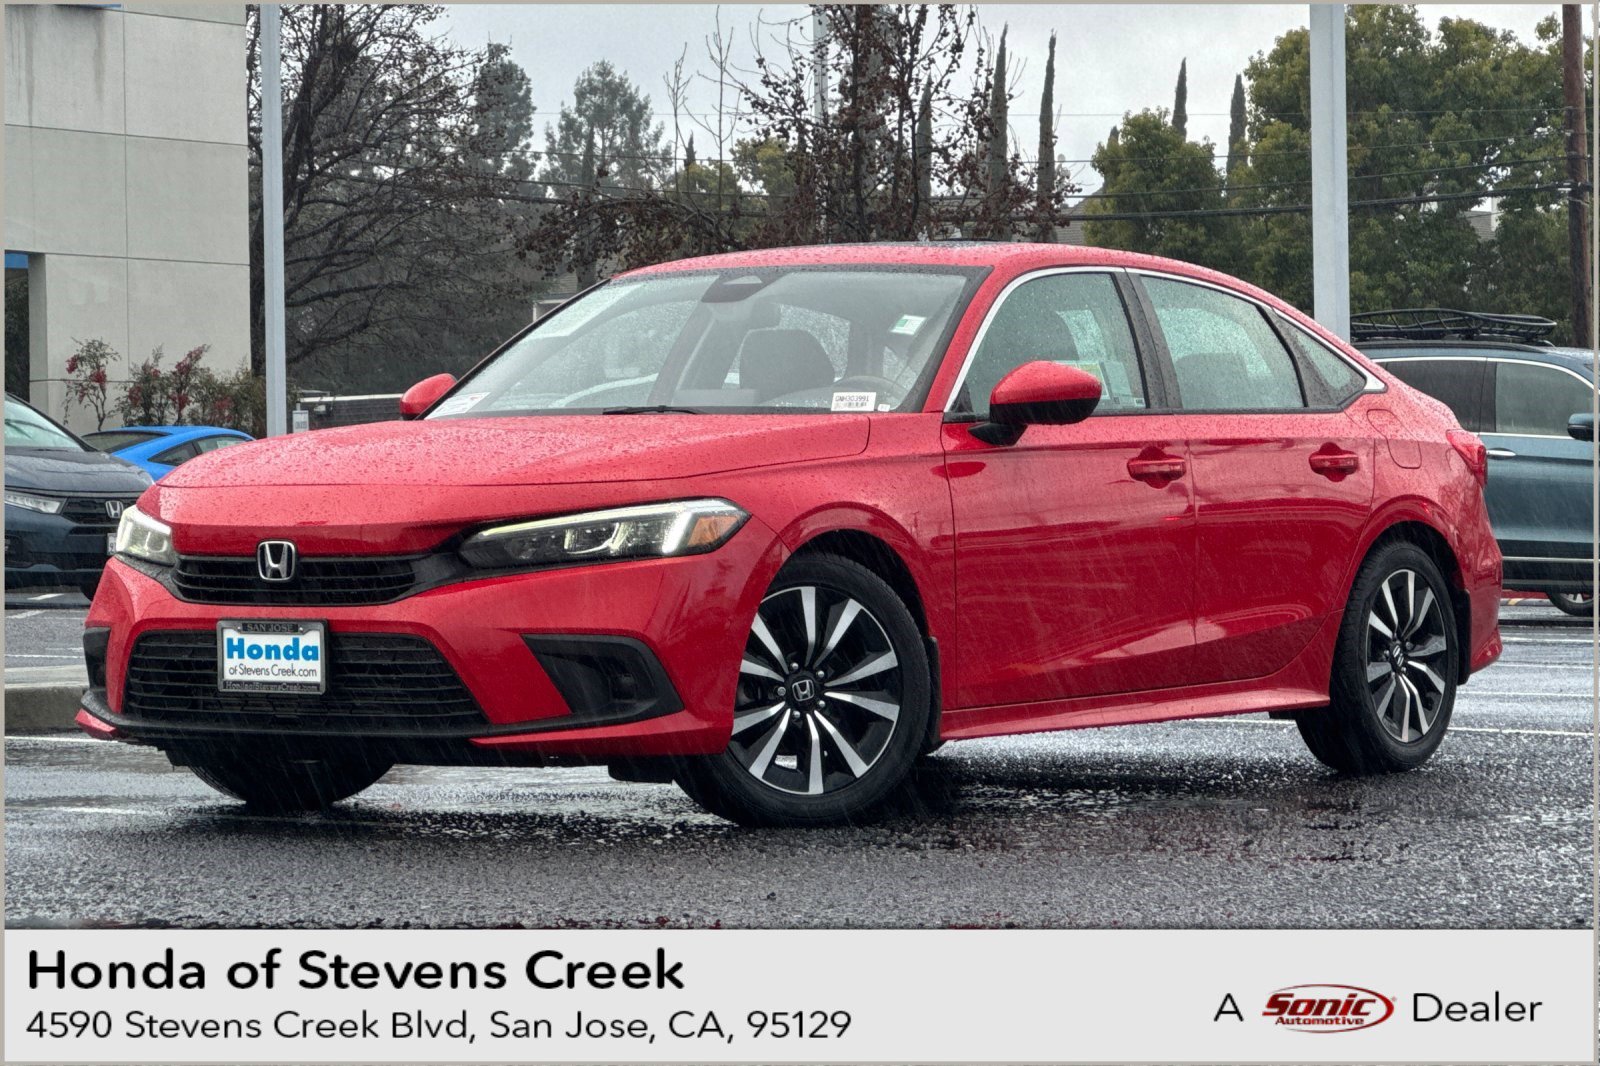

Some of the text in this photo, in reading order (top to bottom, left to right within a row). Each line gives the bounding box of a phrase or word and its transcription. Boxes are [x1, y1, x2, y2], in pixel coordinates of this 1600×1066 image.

[246, 623, 293, 632] SAN JOSE
[226, 637, 319, 661] Honda
[228, 665, 238, 675] of
